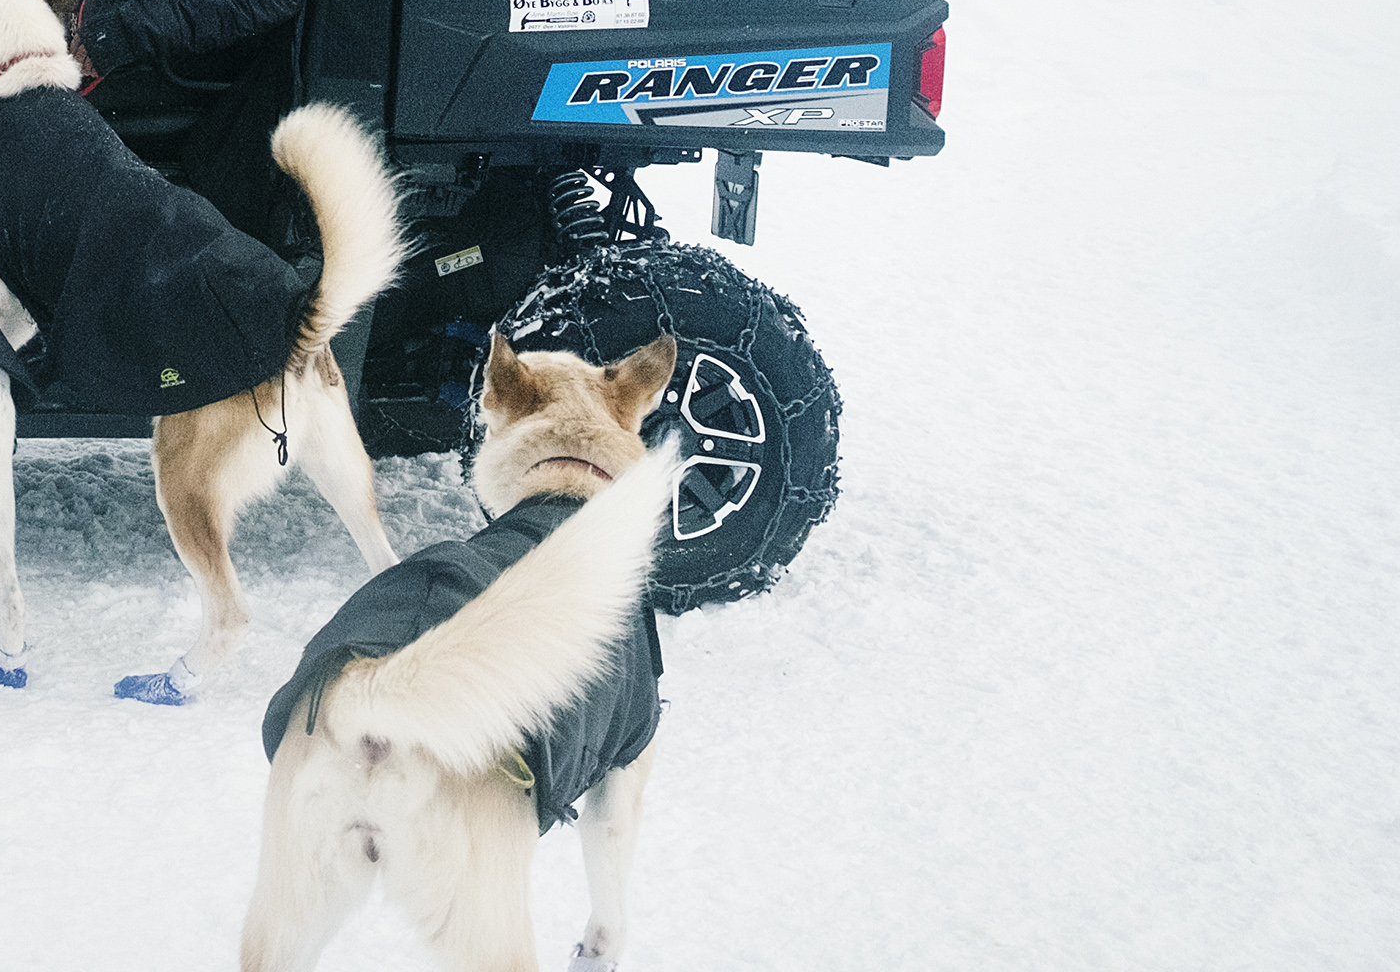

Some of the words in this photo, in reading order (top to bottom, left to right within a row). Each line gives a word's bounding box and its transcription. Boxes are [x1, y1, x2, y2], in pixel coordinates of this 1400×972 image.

[573, 0, 579, 7] &
[627, 58, 687, 69] POLARIS
[566, 54, 881, 105] RANGER
[727, 108, 835, 126] XP
